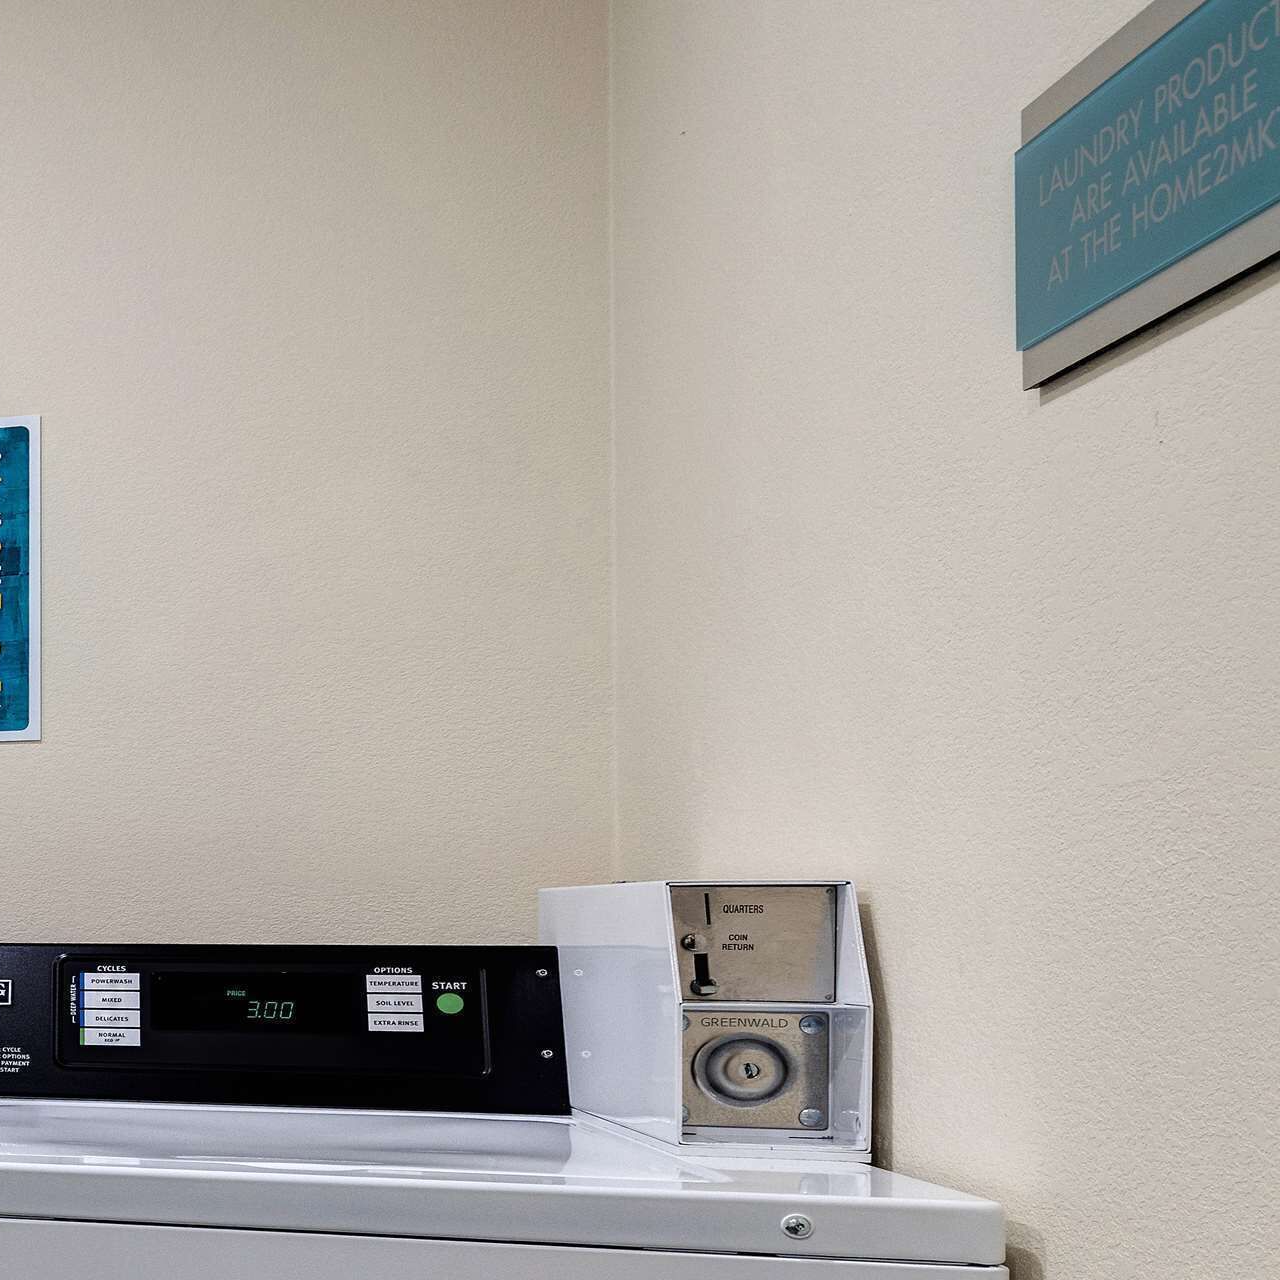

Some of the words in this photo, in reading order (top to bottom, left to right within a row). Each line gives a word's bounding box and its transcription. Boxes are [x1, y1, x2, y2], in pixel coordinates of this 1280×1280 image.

[1040, 99, 1144, 207] LAUNDRY
[1070, 171, 1112, 232] ARE
[1121, 68, 1258, 196] AVAILABLE
[1047, 244, 1073, 292] AT
[1080, 212, 1121, 269] THE
[1132, 106, 1280, 239] HOME2MK
[722, 904, 764, 914] QUARTERS
[728, 934, 748, 942] COIN
[431, 982, 467, 990] START
[247, 1000, 294, 1019] 3.00
[701, 1017, 789, 1029] GREENWALD
